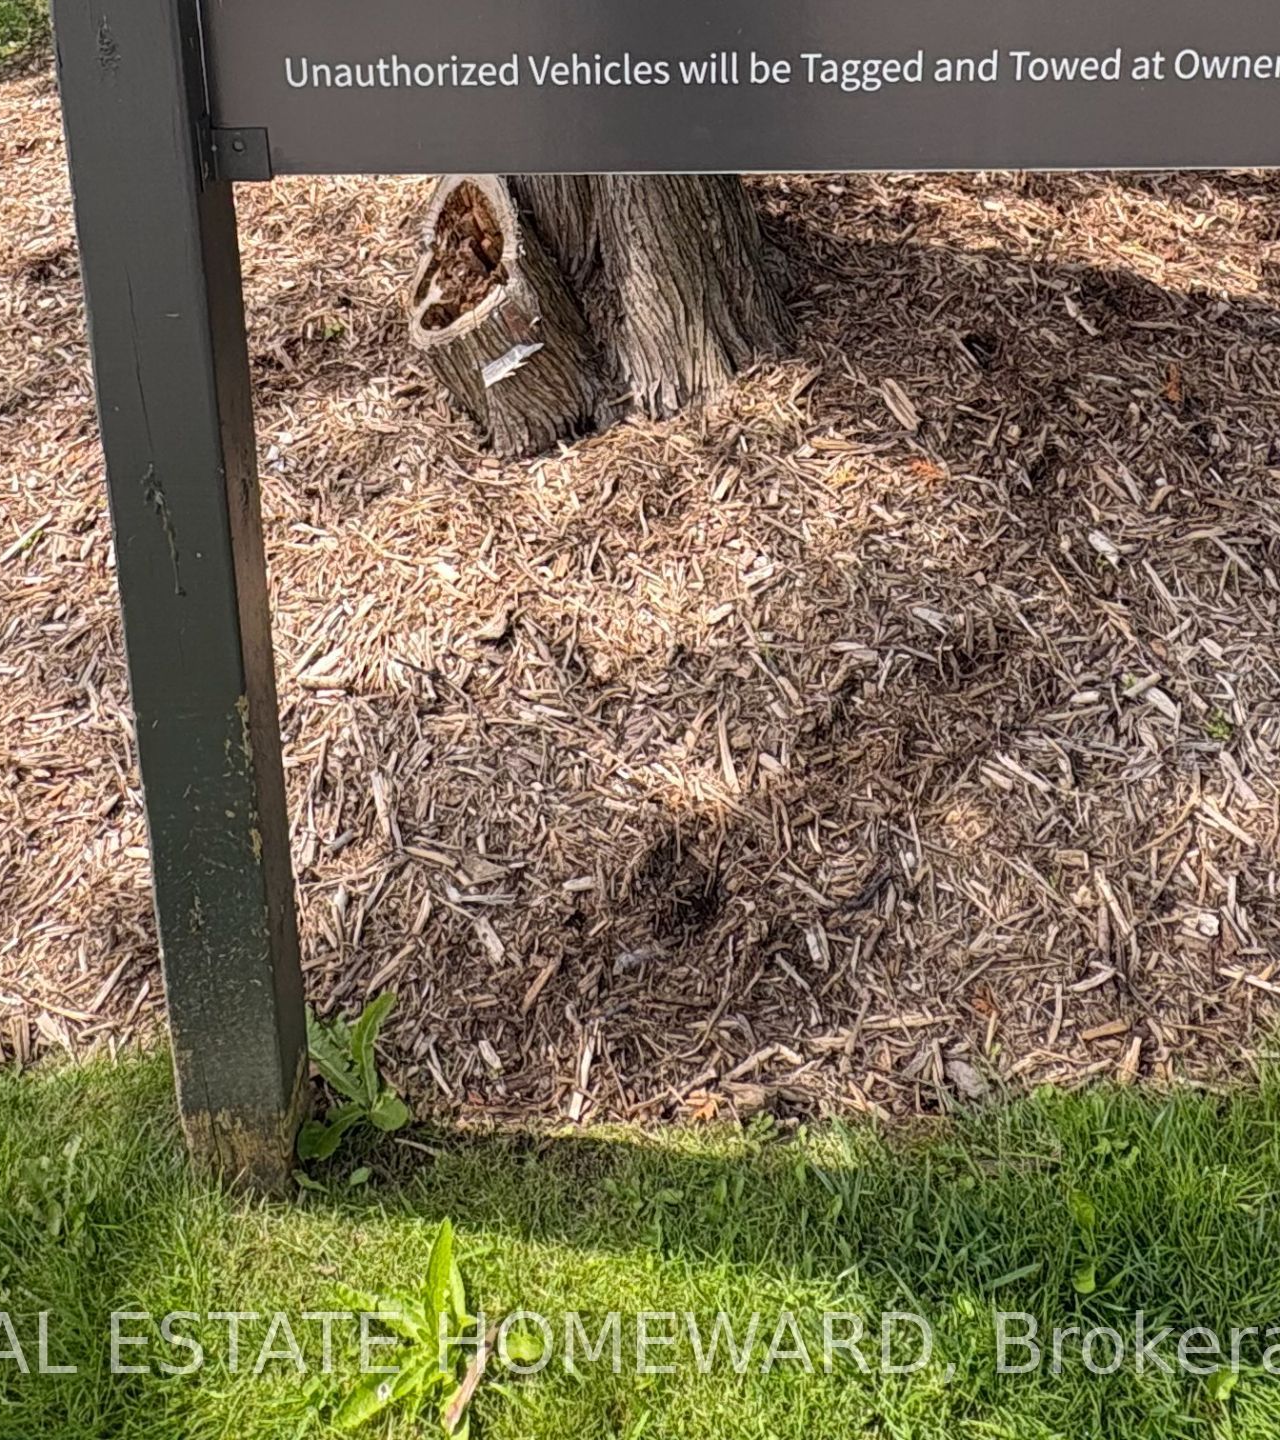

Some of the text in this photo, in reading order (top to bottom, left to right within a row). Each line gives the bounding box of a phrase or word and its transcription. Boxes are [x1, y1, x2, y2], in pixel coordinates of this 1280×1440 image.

[285, 53, 519, 88] Unauthorized
[528, 52, 670, 86] Vehicles
[679, 51, 739, 84] will
[750, 51, 791, 84] be
[800, 49, 923, 92] Tagged
[934, 49, 999, 82] and
[1009, 47, 1122, 81] Towed
[1131, 51, 1166, 80] at
